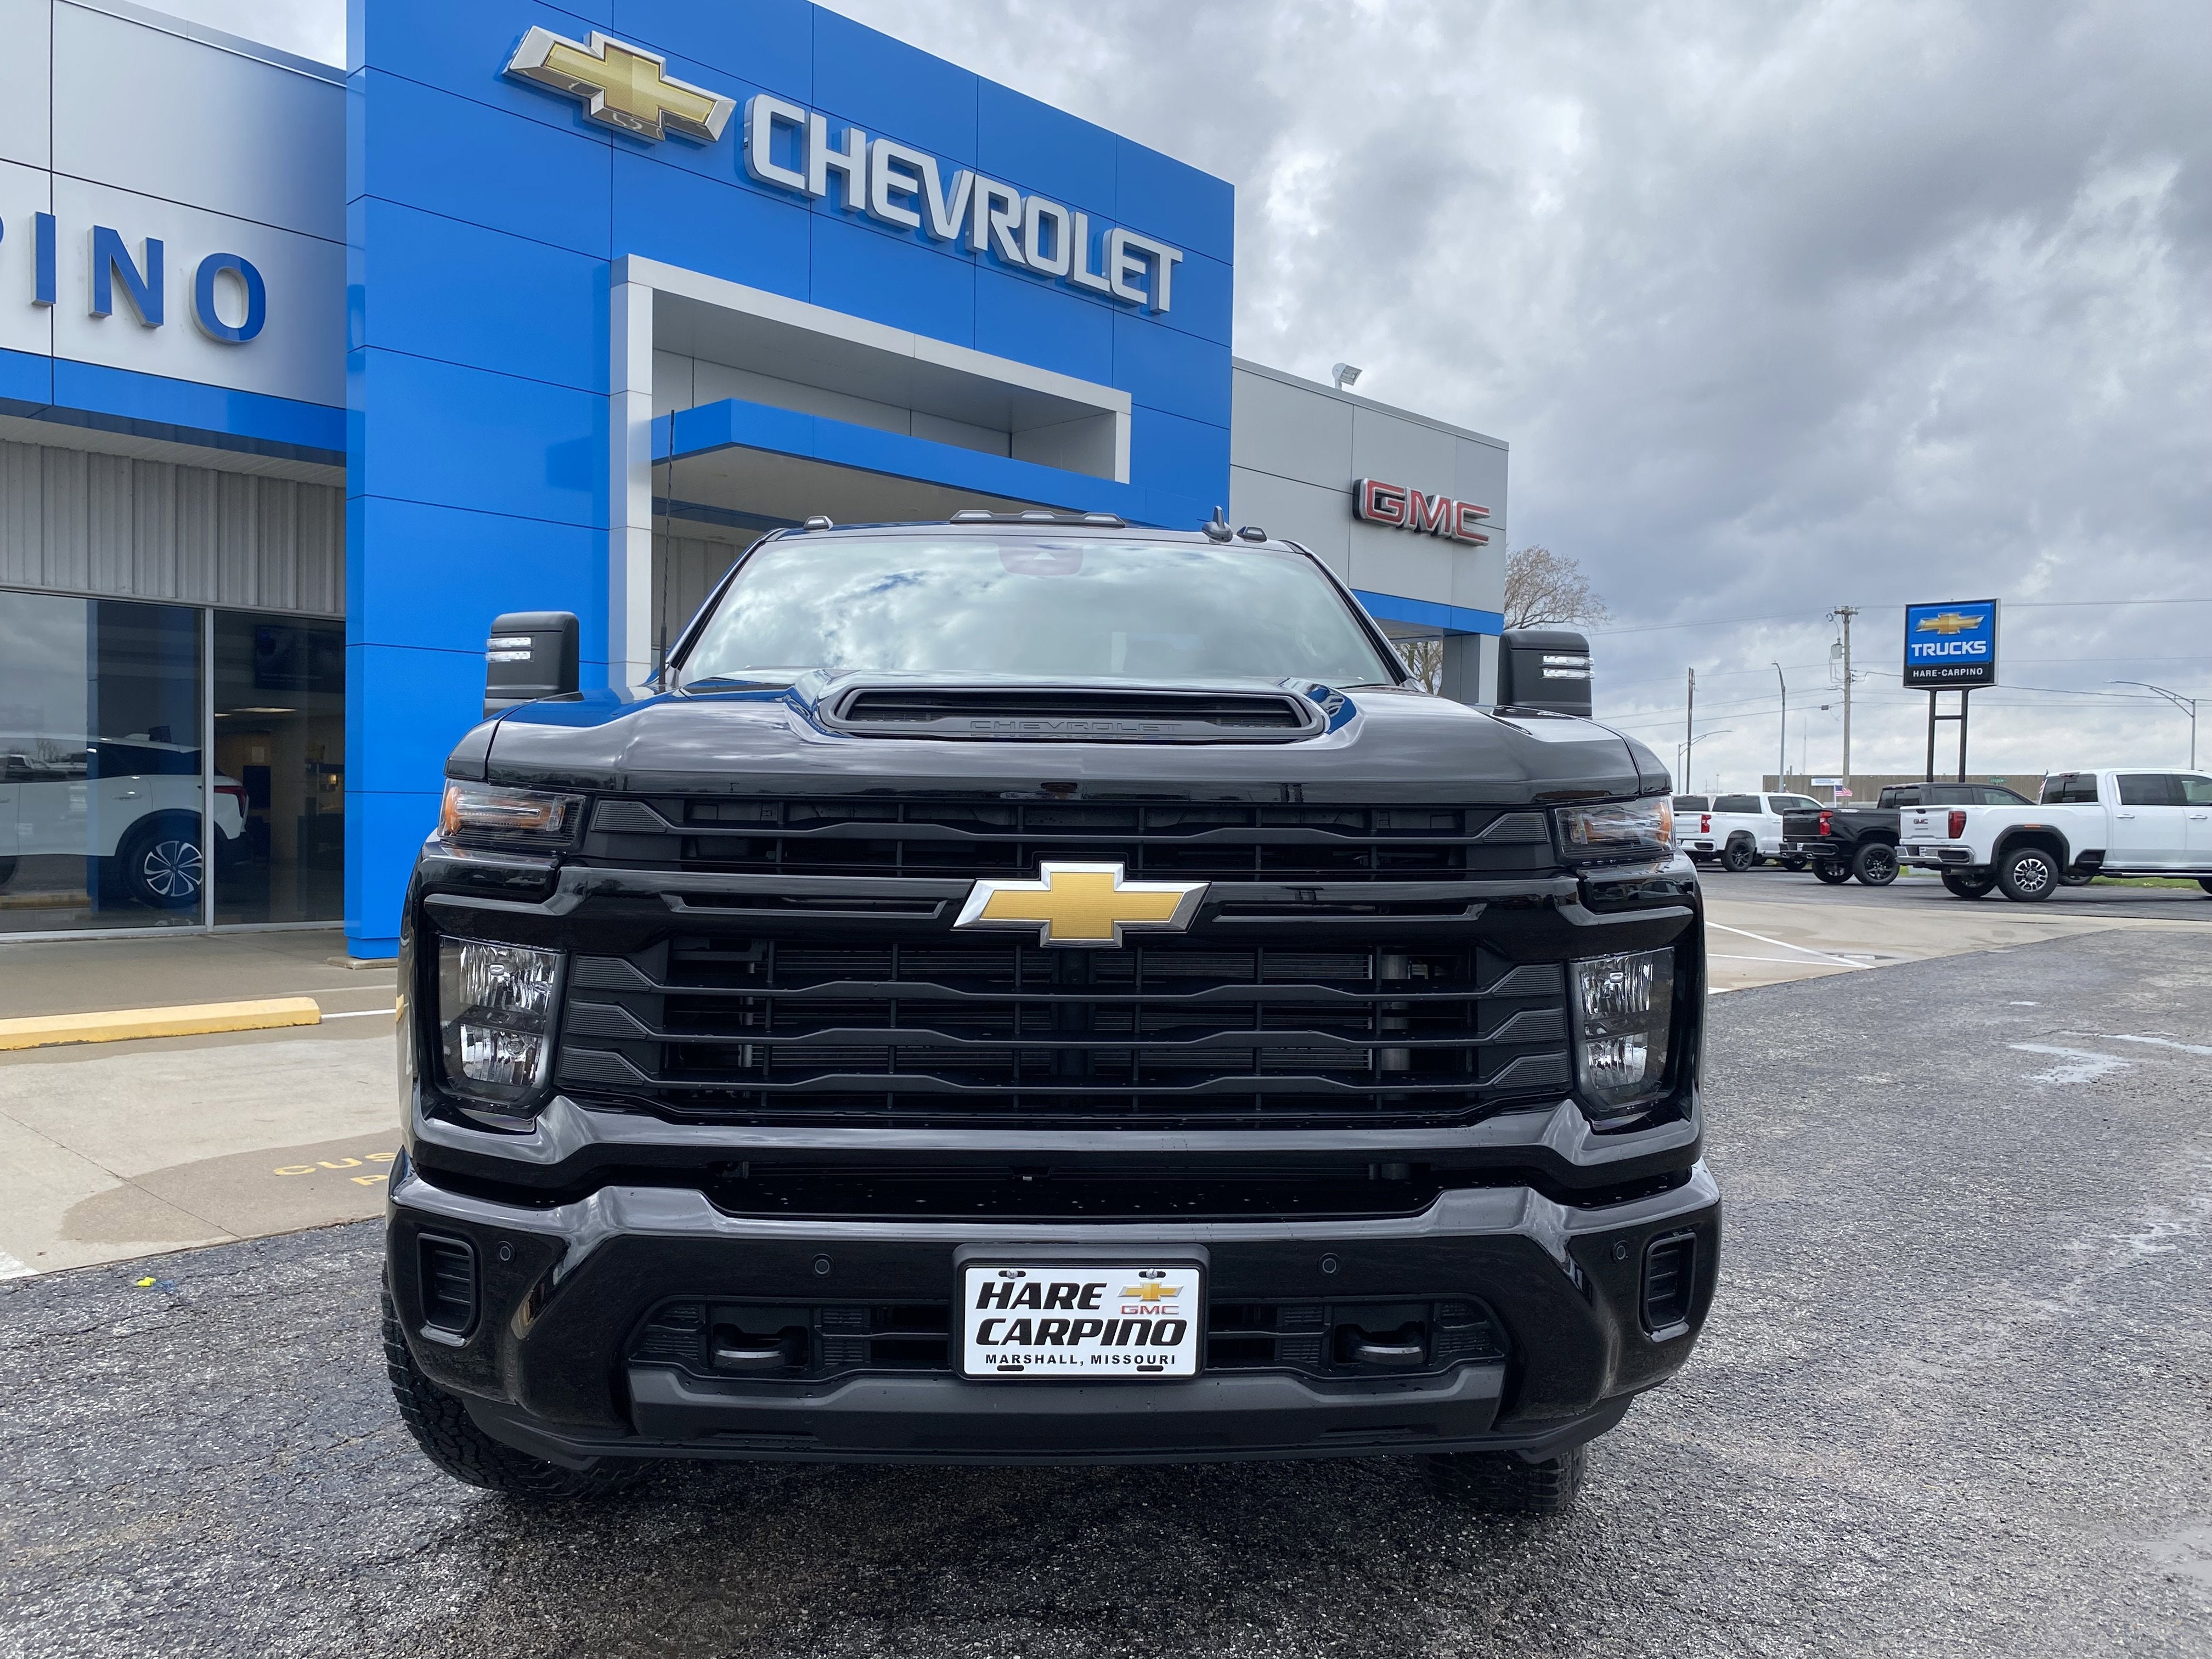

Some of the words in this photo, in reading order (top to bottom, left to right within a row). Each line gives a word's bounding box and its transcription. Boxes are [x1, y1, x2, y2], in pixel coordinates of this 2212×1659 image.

[744, 93, 1183, 313] CHEVROLET
[0, 211, 267, 344] INO
[1352, 477, 1491, 546] GMC
[1911, 641, 1987, 657] TRUCKS
[1913, 668, 1983, 678] HARE-CARPINO
[970, 720, 1183, 732] CHEVROLET
[975, 1282, 1108, 1310] HARE
[1120, 1304, 1180, 1316] GMC
[975, 1318, 1187, 1346] CARPINO
[985, 1353, 1085, 1367] MARSHALL,
[1091, 1353, 1176, 1365] MISSOURI
